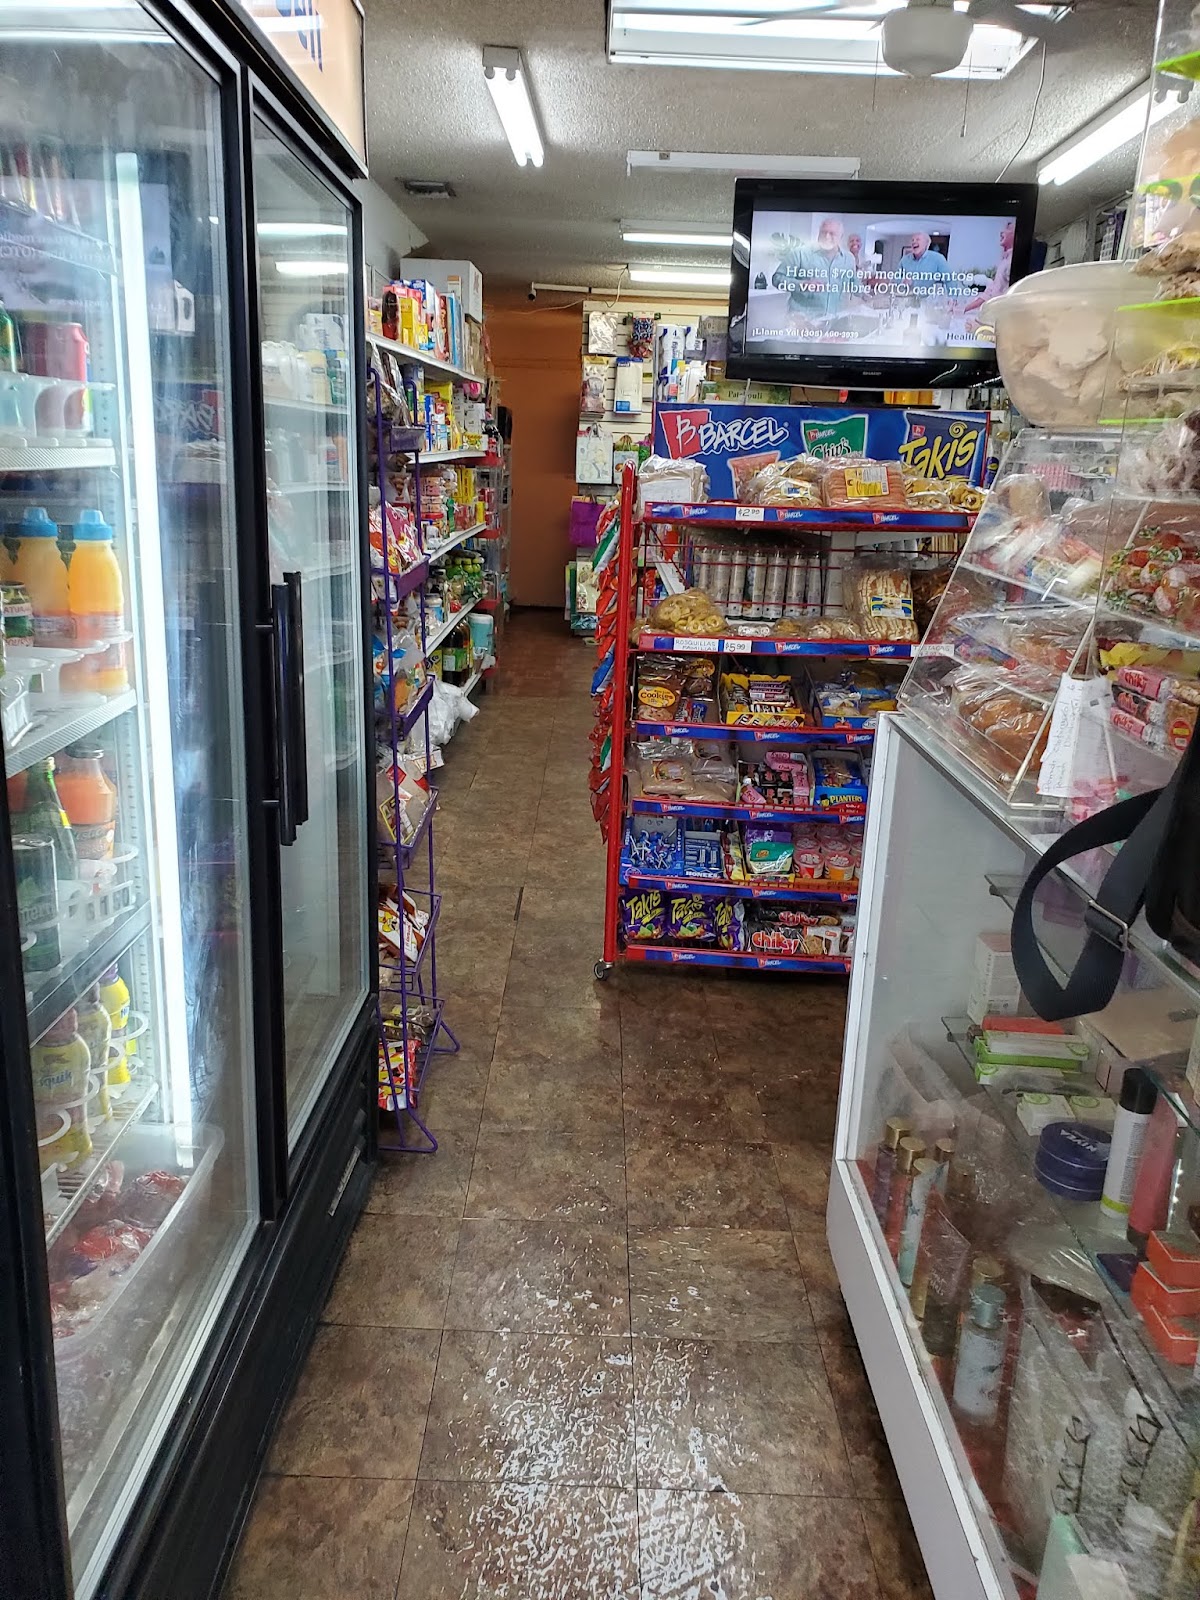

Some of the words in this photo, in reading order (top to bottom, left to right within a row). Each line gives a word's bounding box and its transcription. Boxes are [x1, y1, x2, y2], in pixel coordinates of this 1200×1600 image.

[786, 266, 828, 278] Hasta
[831, 268, 854, 279] $70
[857, 271, 871, 279] en
[875, 269, 974, 282] medicamentos
[778, 280, 796, 292] de
[800, 284, 840, 293] venta
[843, 283, 871, 294] libre
[873, 284, 910, 296] (OTC)
[913, 285, 945, 296] cada
[948, 288, 979, 297] mes
[801, 329, 822, 338] (305)
[699, 418, 785, 453] BARCEL
[899, 430, 978, 480] Takis
[640, 692, 673, 700] Cookies
[830, 795, 863, 803] PLANTERS
[752, 931, 801, 954] Chiky
[1060, 1129, 1097, 1152] NIVEA
